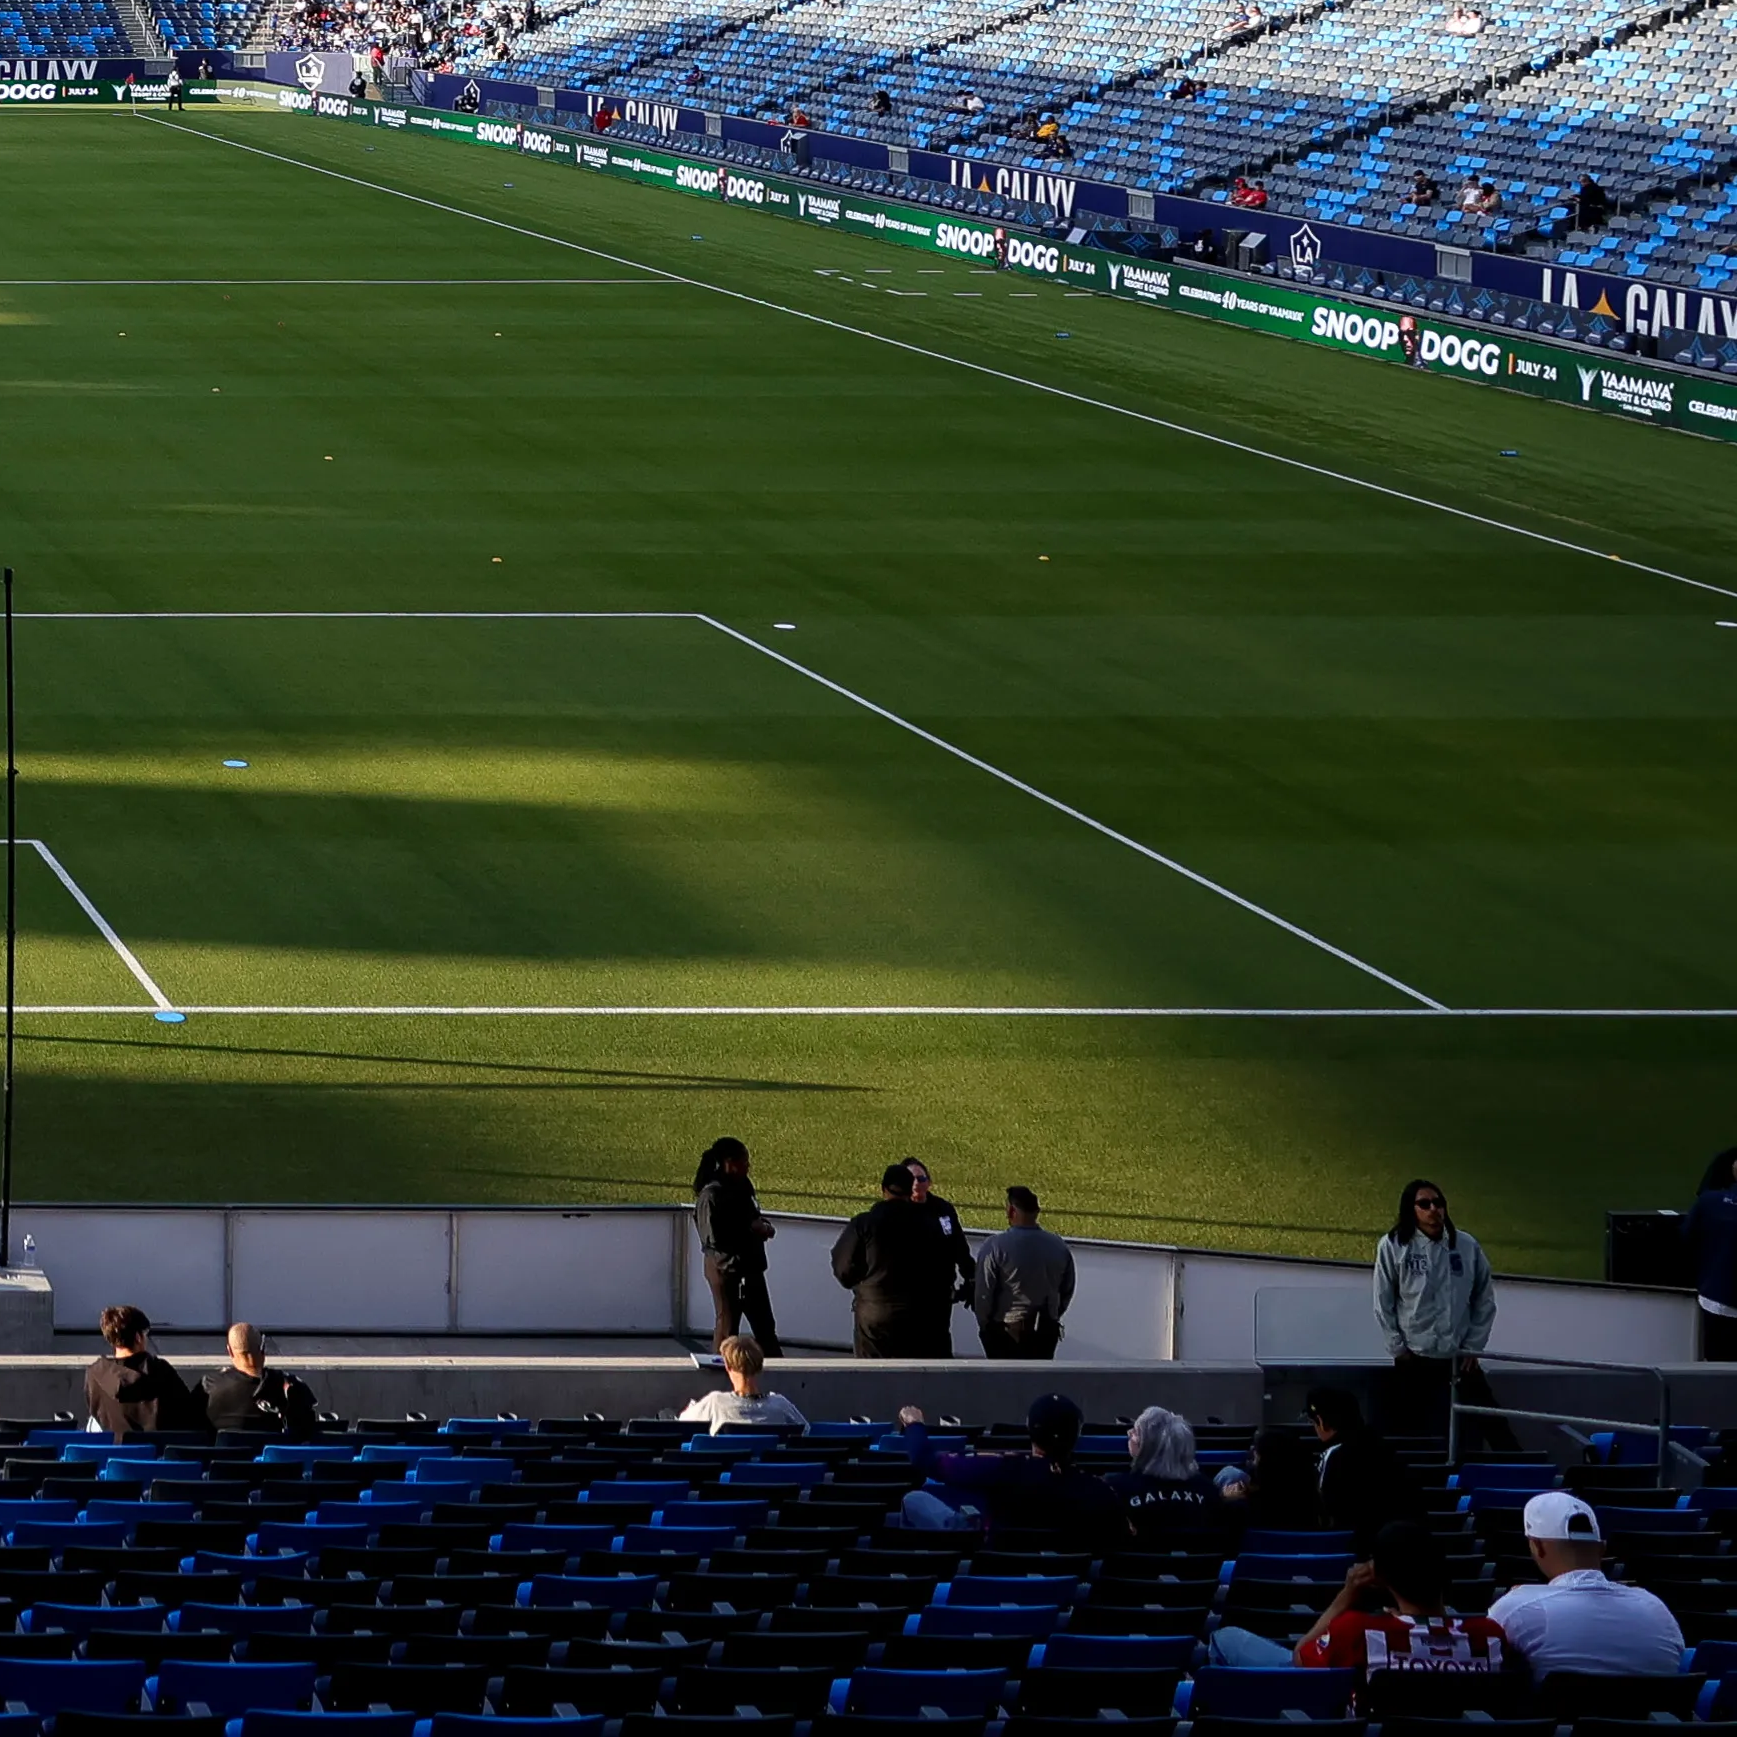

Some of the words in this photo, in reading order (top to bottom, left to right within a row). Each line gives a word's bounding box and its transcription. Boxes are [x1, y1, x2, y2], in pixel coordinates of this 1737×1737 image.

[302, 65, 319, 77] LA
[68, 88, 86, 96] JULY
[279, 90, 312, 110] SNOOP
[319, 98, 348, 117] DOGG
[477, 122, 516, 144] SNOOP
[524, 130, 552, 154] DOGG
[677, 165, 717, 192] SNOOP
[728, 177, 765, 203] DOGG
[936, 223, 995, 257] SNOOP
[1008, 238, 1059, 273] DOGG
[1296, 244, 1314, 263] LA
[1068, 258, 1085, 272] JULY
[1085, 263, 1096, 275] 24
[1123, 265, 1171, 288] YAAMAVA'
[1179, 286, 1222, 304] CELEBRATING
[1222, 290, 1237, 310] 40
[1237, 298, 1258, 313] YEARS
[1259, 302, 1269, 315] OF
[1312, 306, 1400, 350] SNOOP
[1420, 329, 1501, 375] DOGG
[1515, 359, 1543, 379] JULY
[1543, 365, 1558, 382] 24
[1601, 370, 1675, 402] YAAMAVA'
[1602, 387, 1633, 406] RESORT
[1641, 396, 1672, 412] CASINO
[1130, 1491, 1204, 1507] GALAXY
